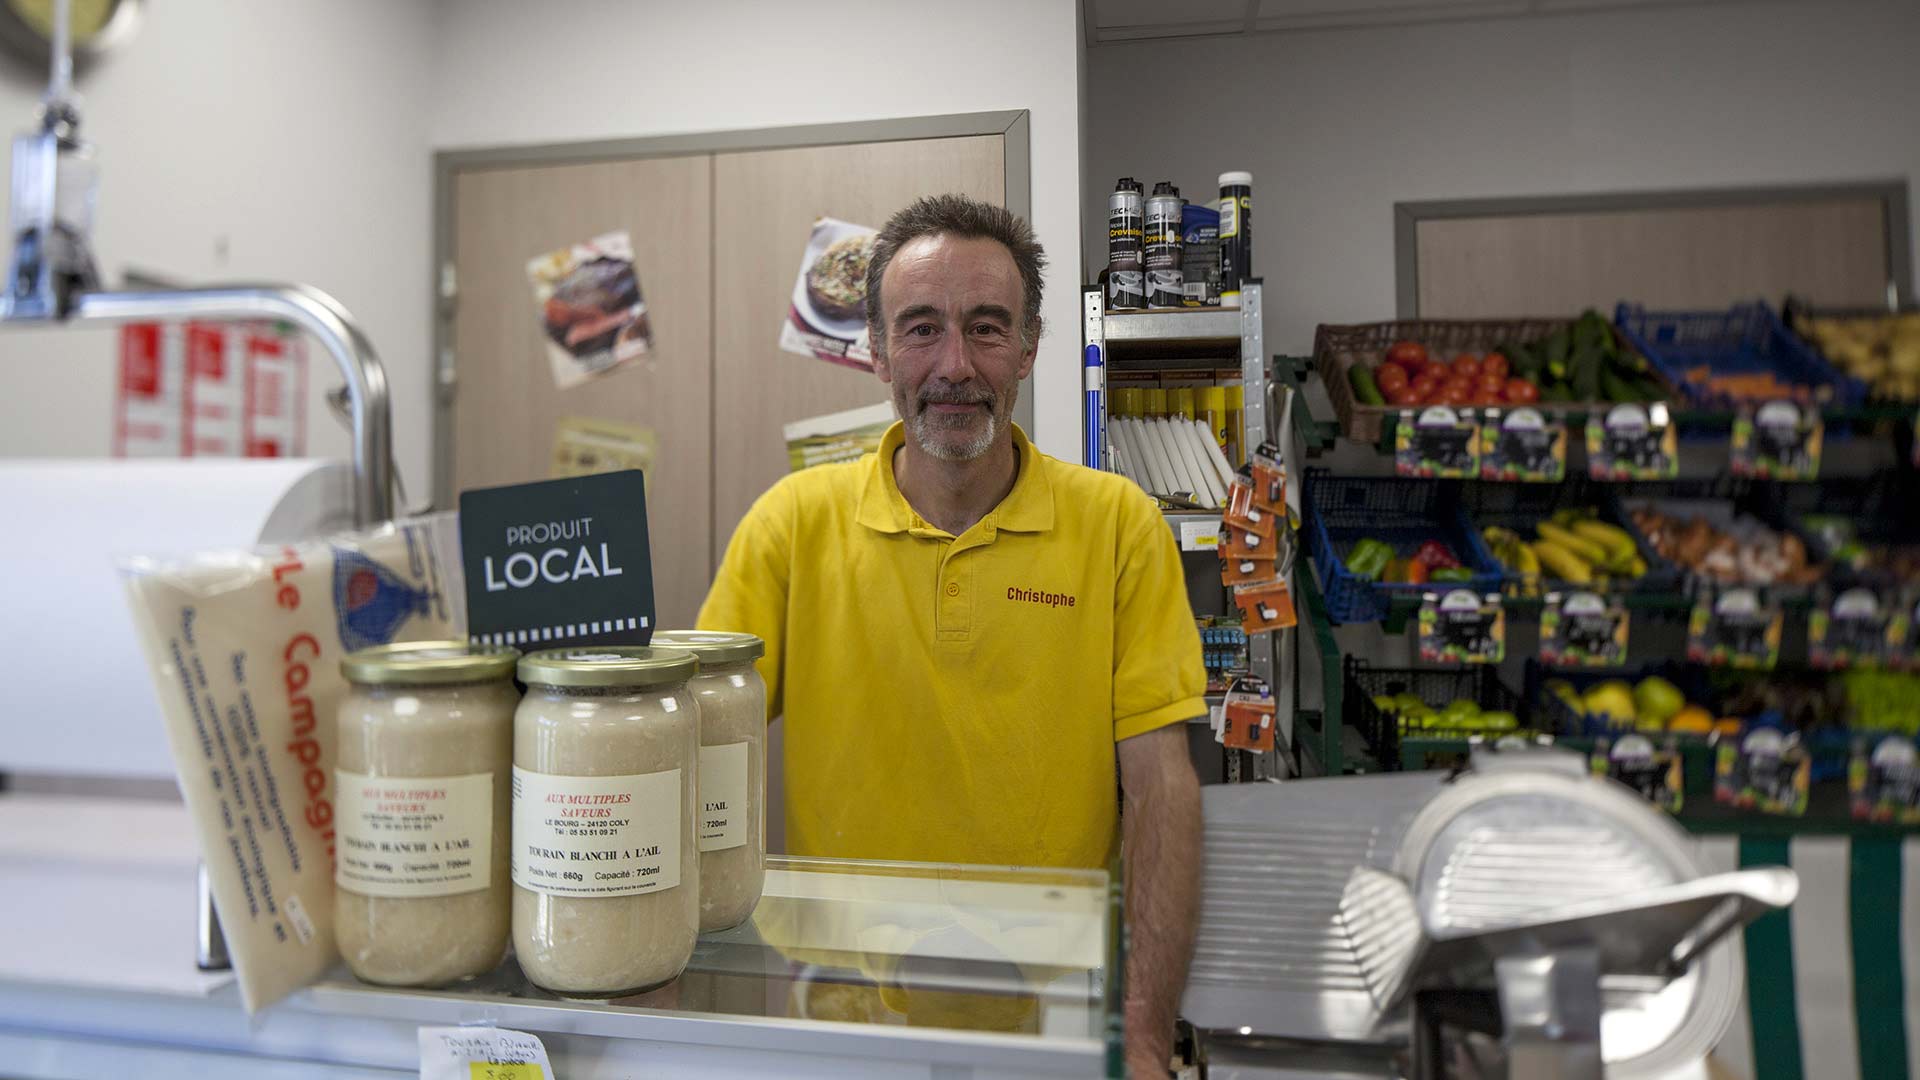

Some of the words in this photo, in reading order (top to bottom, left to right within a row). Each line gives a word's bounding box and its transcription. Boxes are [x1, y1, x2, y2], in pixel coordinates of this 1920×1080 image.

[506, 517, 592, 546] PRODUIT
[484, 542, 623, 592] LOCAL
[1007, 587, 1076, 608] Christophe
[544, 794, 565, 804] AUX
[567, 793, 632, 805] MULTIPLES
[705, 801, 728, 811] L'AIL
[561, 808, 612, 818] SAVEURS
[554, 819, 579, 827] BOURG
[587, 820, 608, 828] 24120
[609, 819, 630, 827] COLY
[706, 818, 728, 828] 720ml
[528, 845, 565, 860] TOURAIN
[570, 851, 617, 861] BLANCHI
[622, 850, 631, 860] A
[635, 845, 661, 858] L'AIL
[545, 868, 558, 878] Net
[563, 870, 583, 882] 660g
[595, 869, 631, 881] Capacité
[636, 865, 660, 876] 720ml
